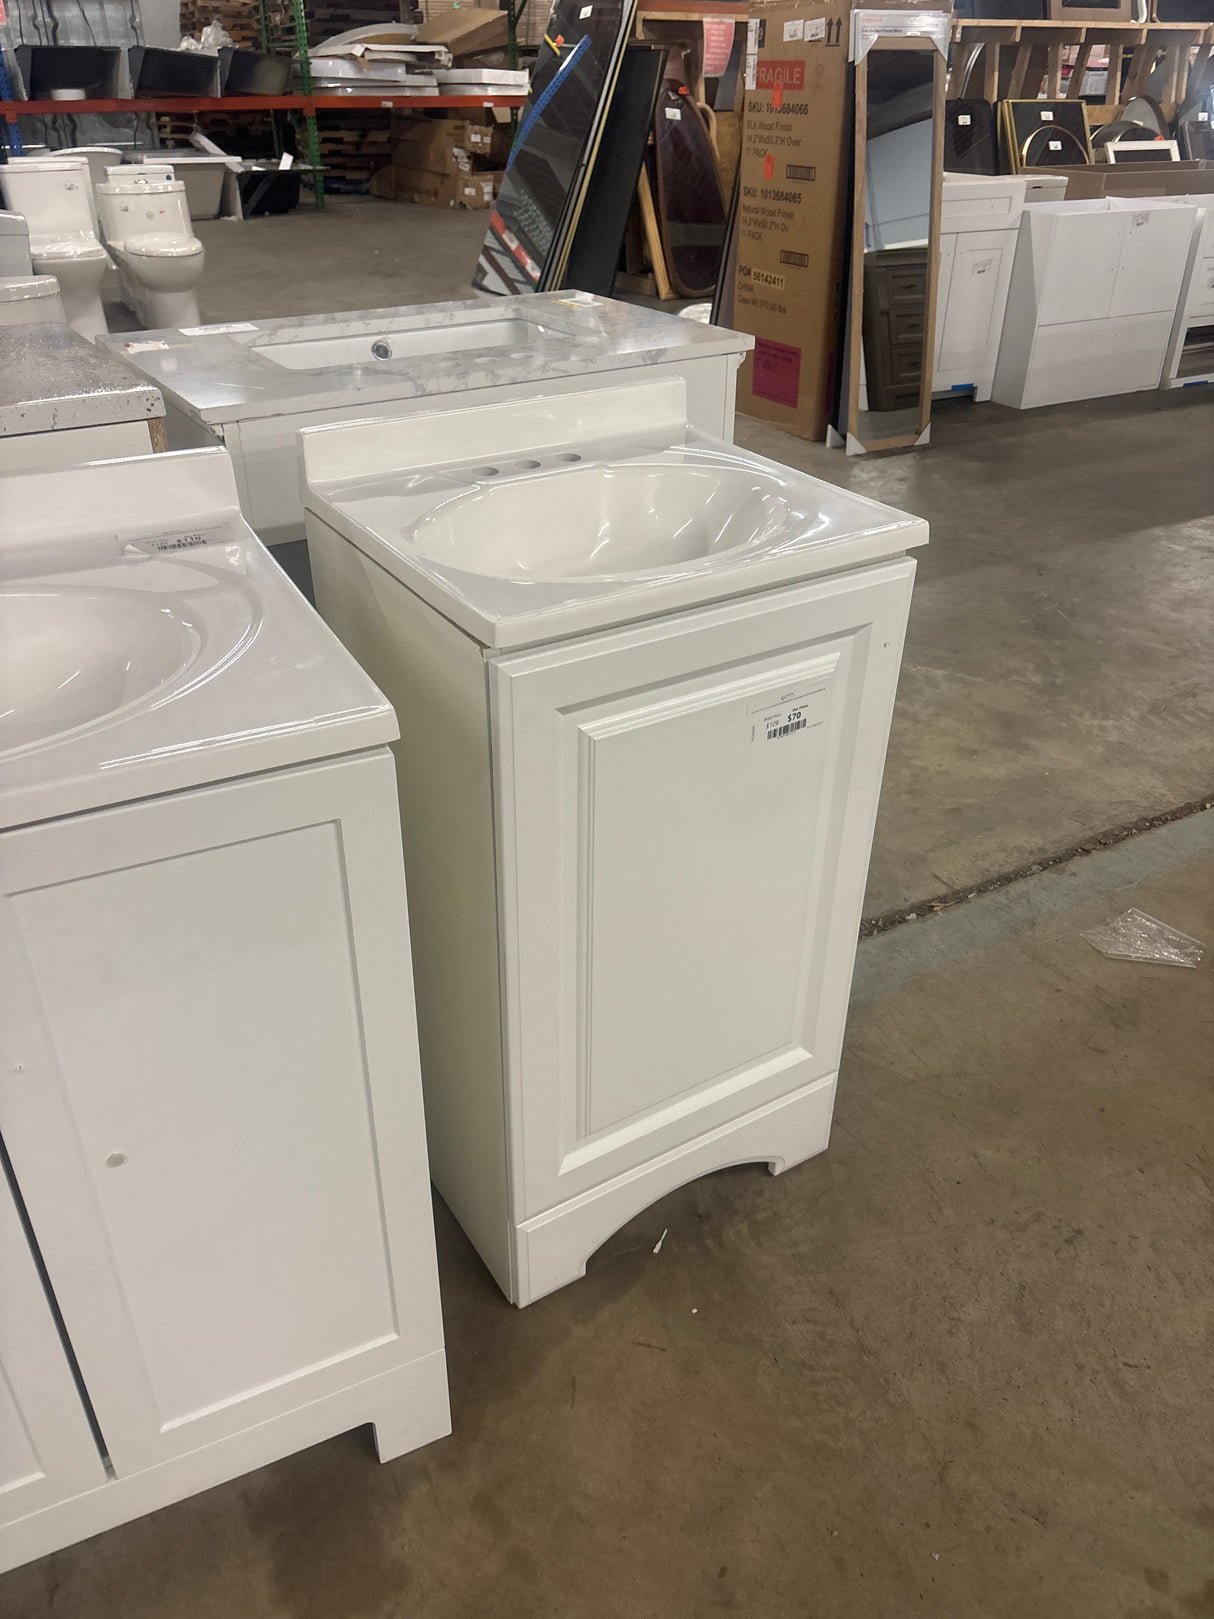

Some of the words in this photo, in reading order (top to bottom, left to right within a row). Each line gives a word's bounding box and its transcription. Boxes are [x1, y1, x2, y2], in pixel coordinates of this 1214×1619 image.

[748, 101, 764, 113] SKU:
[758, 120, 774, 131] Wood
[775, 121, 792, 132] Finish
[743, 186, 759, 198] SKU:
[760, 188, 802, 205] 1013684065
[760, 207, 776, 218] Wood
[777, 208, 795, 220] Finish
[738, 265, 751, 277] PO#
[752, 271, 784, 288] 56142411
[787, 712, 801, 722] $70
